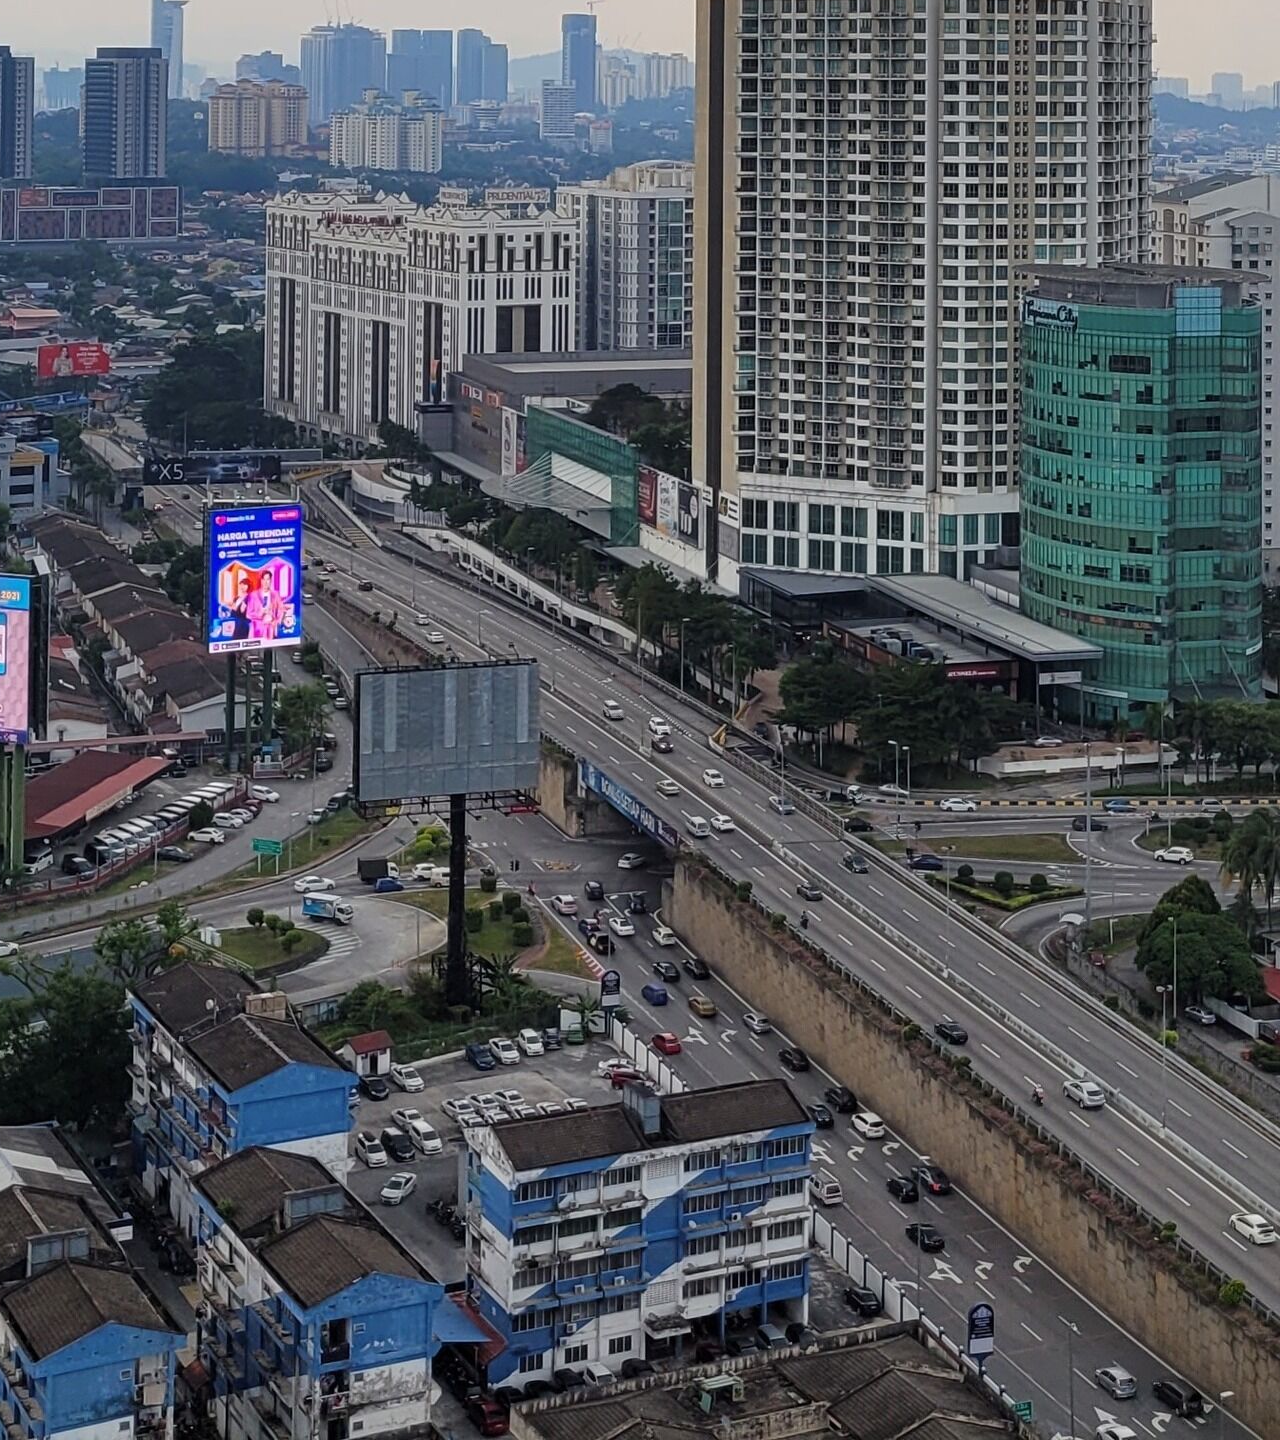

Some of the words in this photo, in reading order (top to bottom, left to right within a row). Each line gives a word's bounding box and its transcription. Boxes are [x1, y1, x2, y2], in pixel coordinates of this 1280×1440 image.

[159, 464, 184, 480] X5
[217, 532, 248, 542] HARGA
[1, 590, 21, 601] 2021
